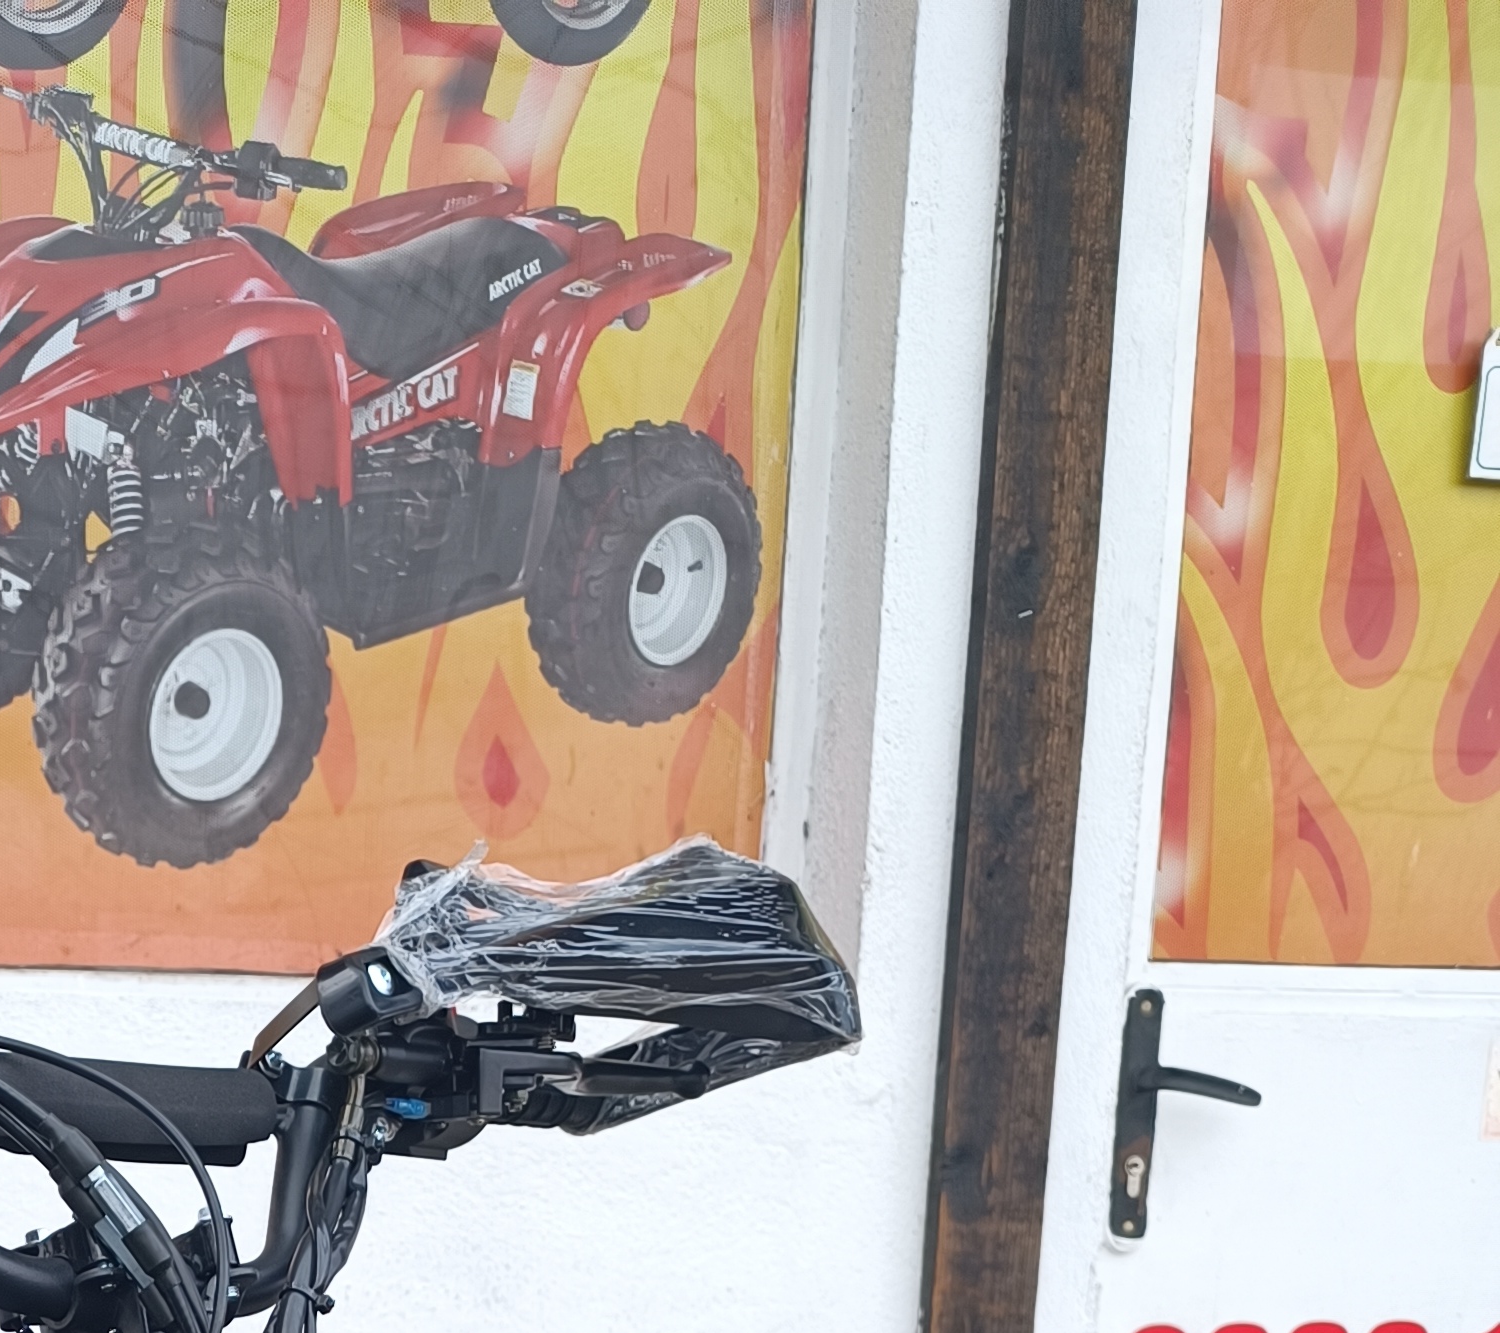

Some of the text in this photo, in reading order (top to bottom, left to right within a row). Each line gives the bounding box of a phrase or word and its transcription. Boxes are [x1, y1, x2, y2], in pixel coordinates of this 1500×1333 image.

[488, 258, 542, 302] ARCTIC CAT
[349, 382, 415, 441] RCTIC
[417, 365, 458, 409] CAT
